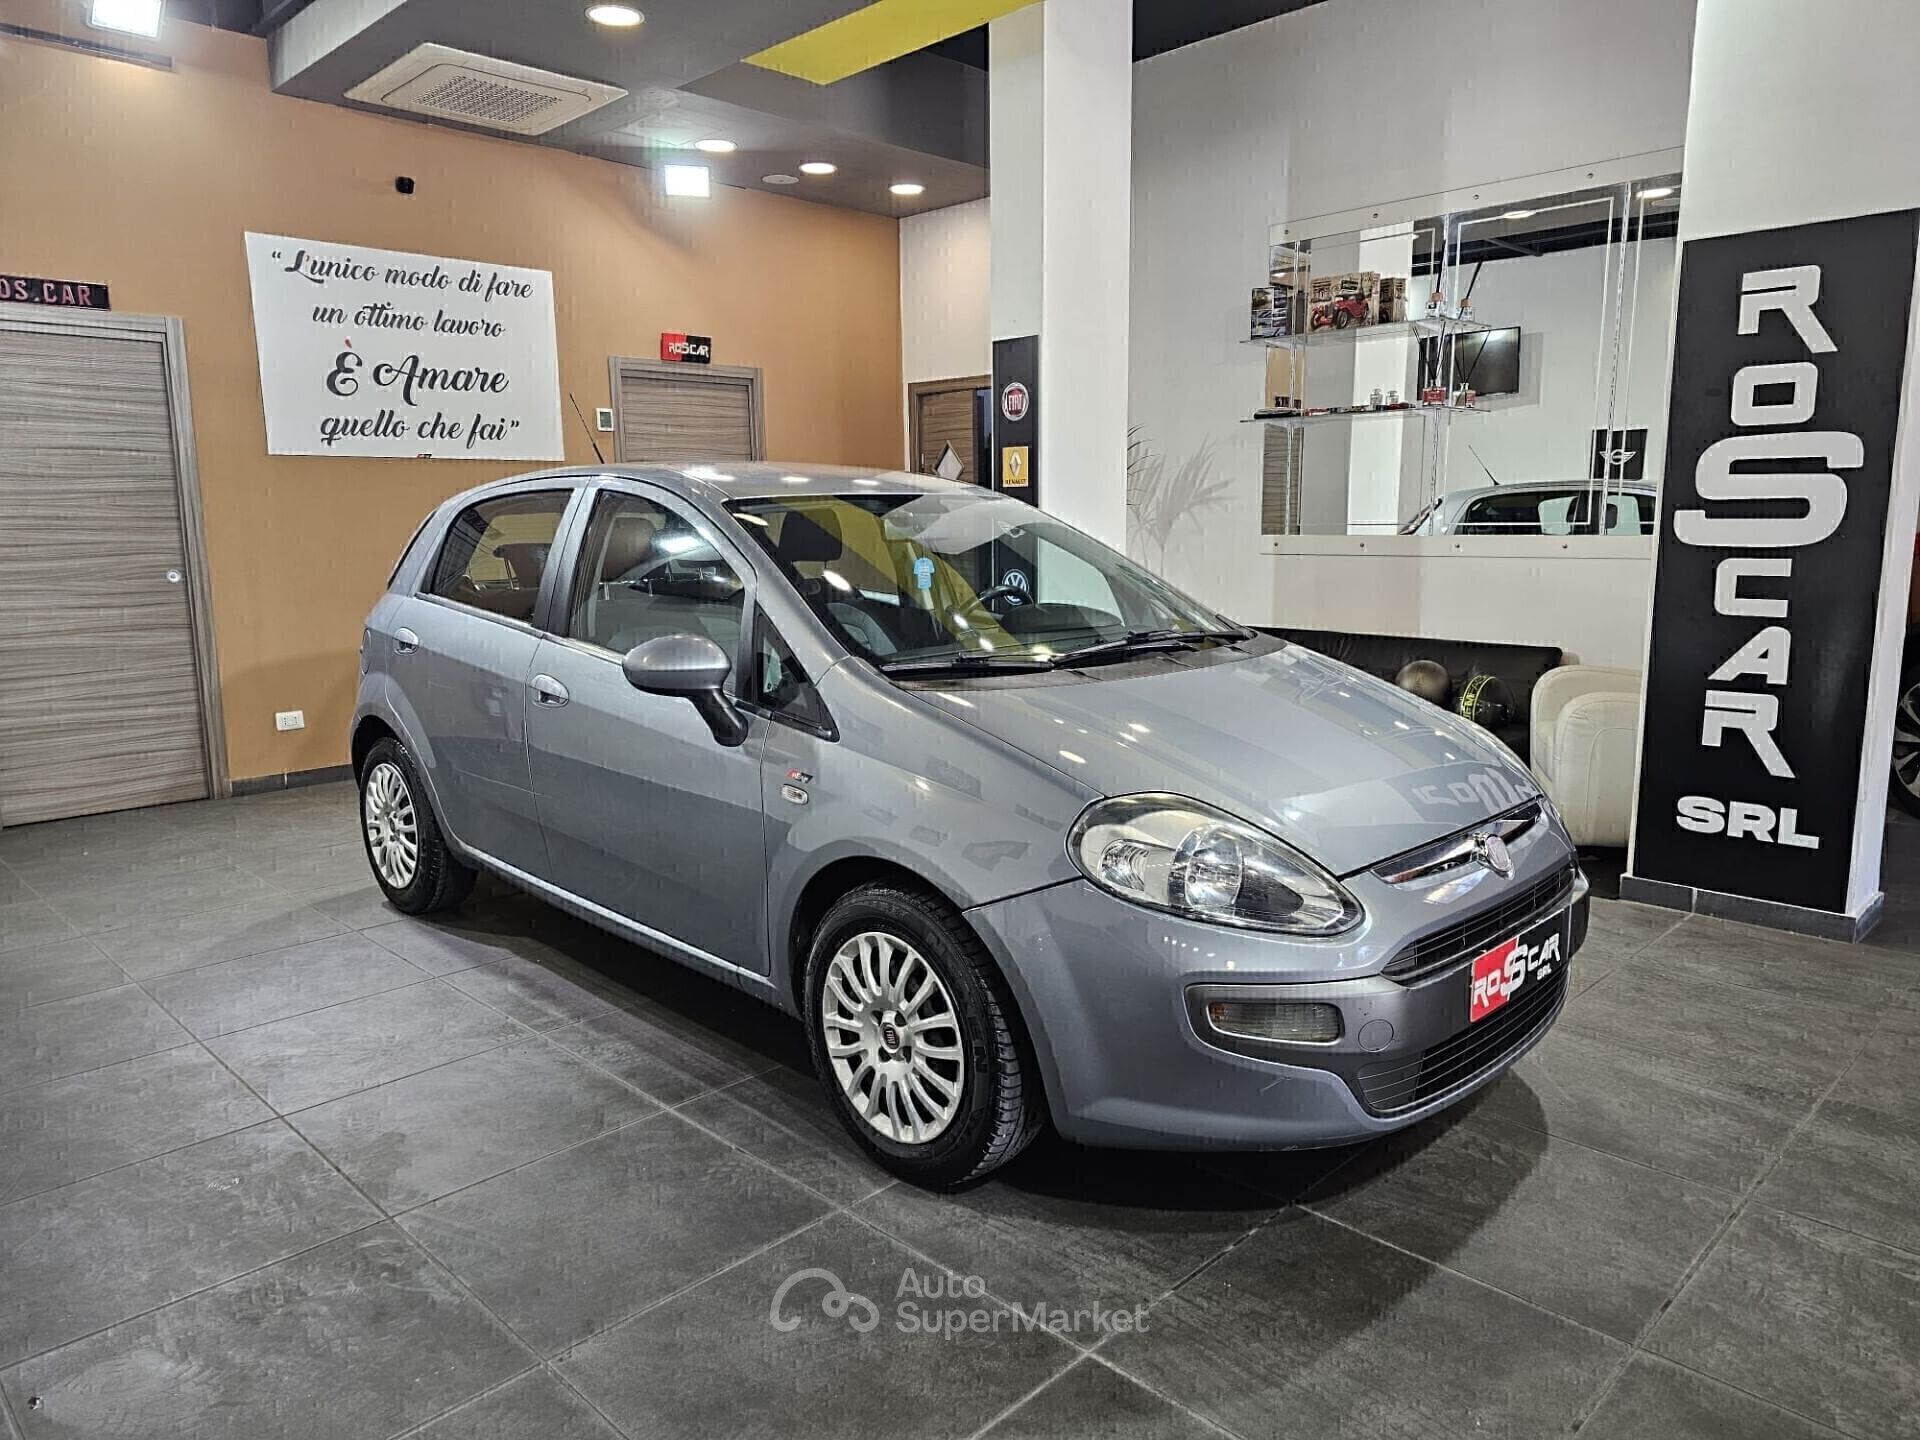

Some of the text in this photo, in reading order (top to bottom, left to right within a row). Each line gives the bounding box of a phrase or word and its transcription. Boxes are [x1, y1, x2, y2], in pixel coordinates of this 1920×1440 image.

[384, 265, 451, 290] modo
[458, 269, 483, 294] di
[484, 272, 533, 303] fare
[312, 302, 505, 337] un ottimo lavoro
[326, 338, 510, 407] È Amare
[320, 409, 410, 447] quello
[417, 412, 464, 440] che
[1676, 795, 1820, 849] SRL
